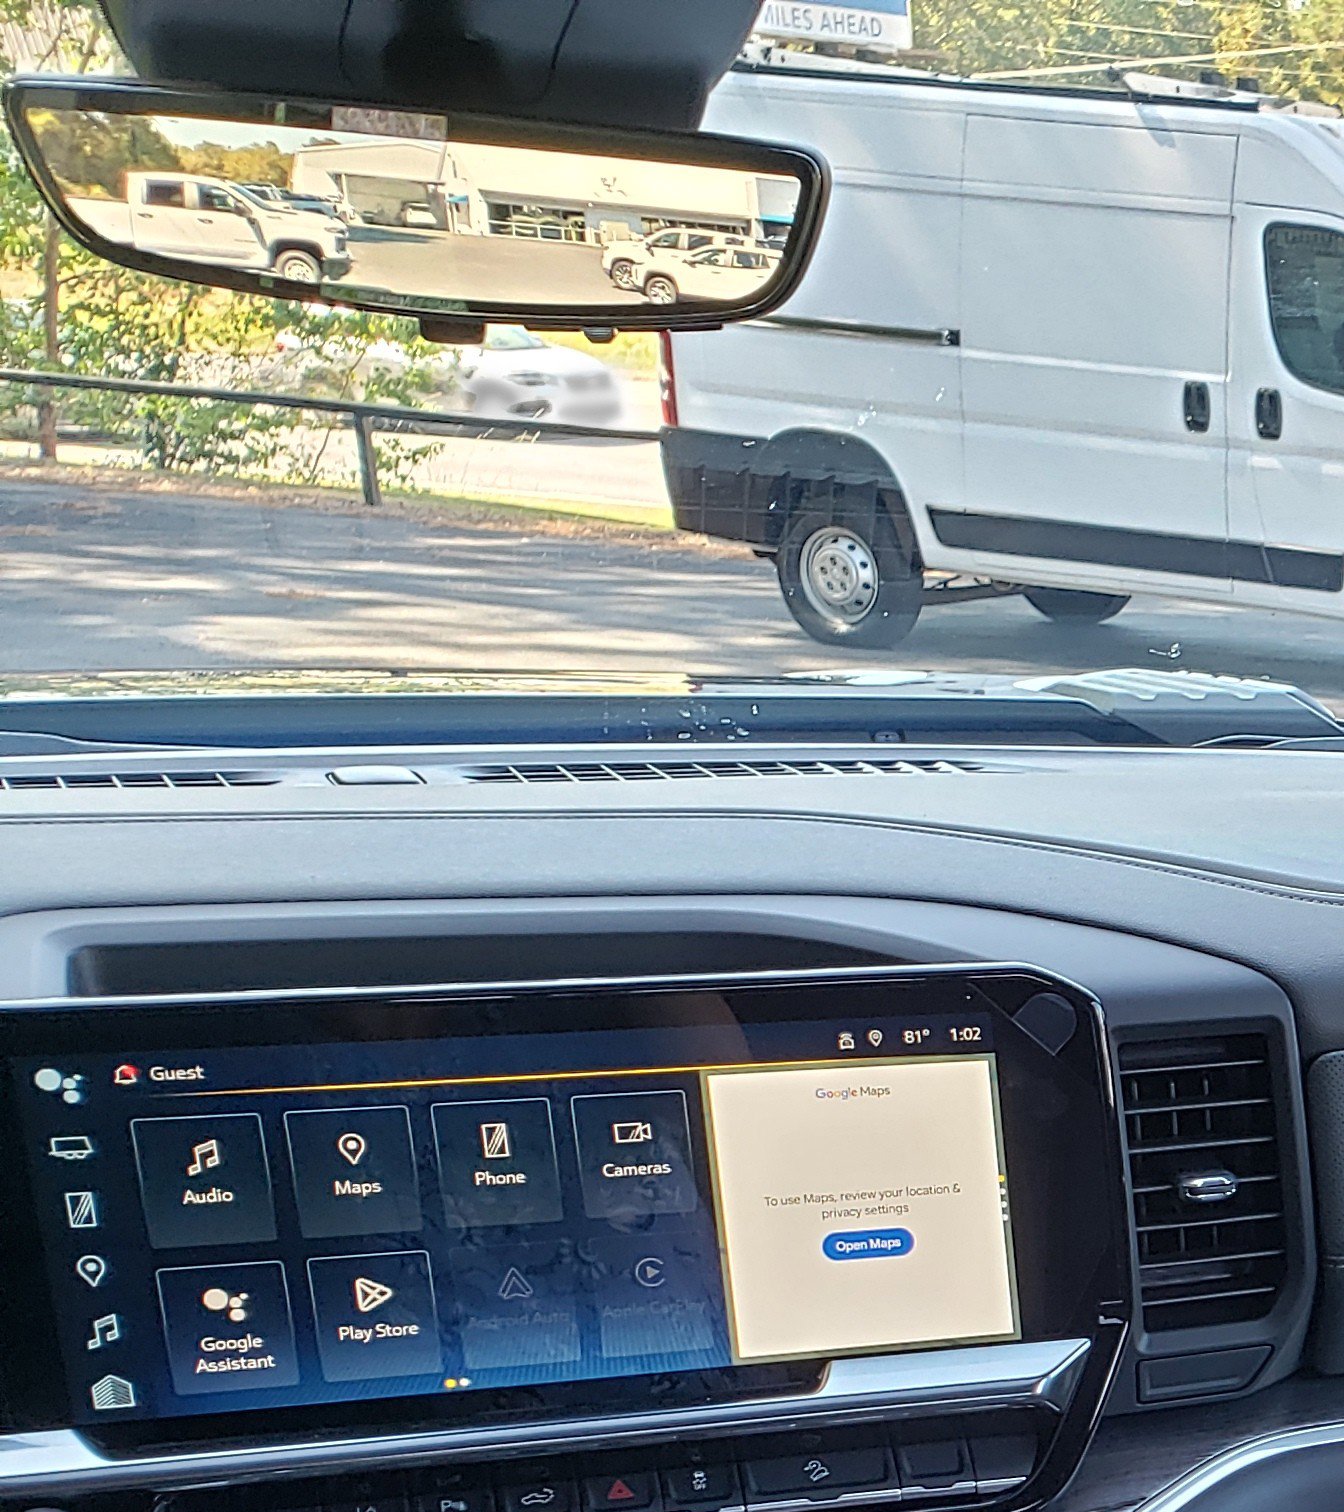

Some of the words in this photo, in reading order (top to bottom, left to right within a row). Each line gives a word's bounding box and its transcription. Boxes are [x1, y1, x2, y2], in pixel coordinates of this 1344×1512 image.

[820, 12, 882, 37] AHEAD
[950, 1027, 982, 1042] 1:02
[150, 1066, 205, 1081] Guest
[815, 1087, 858, 1100] Google
[860, 1085, 891, 1098] Maps
[474, 1171, 526, 1186] Phone
[602, 1163, 672, 1178] Cameras
[183, 1188, 234, 1204] Audio
[334, 1180, 383, 1197] Maps
[764, 1196, 778, 1207] To
[780, 1196, 801, 1206] use
[803, 1193, 837, 1204] Maps,
[840, 1190, 877, 1202] review
[879, 1188, 904, 1201] your
[906, 1184, 950, 1197] location
[952, 1183, 961, 1193] &
[821, 1206, 862, 1221] privacy
[865, 1203, 909, 1216] settings
[836, 1239, 868, 1255] Open
[869, 1237, 902, 1251] Maps
[338, 1326, 373, 1343] Play
[375, 1322, 420, 1338] Store
[200, 1333, 264, 1353] Google
[196, 1354, 276, 1374] Assistant
